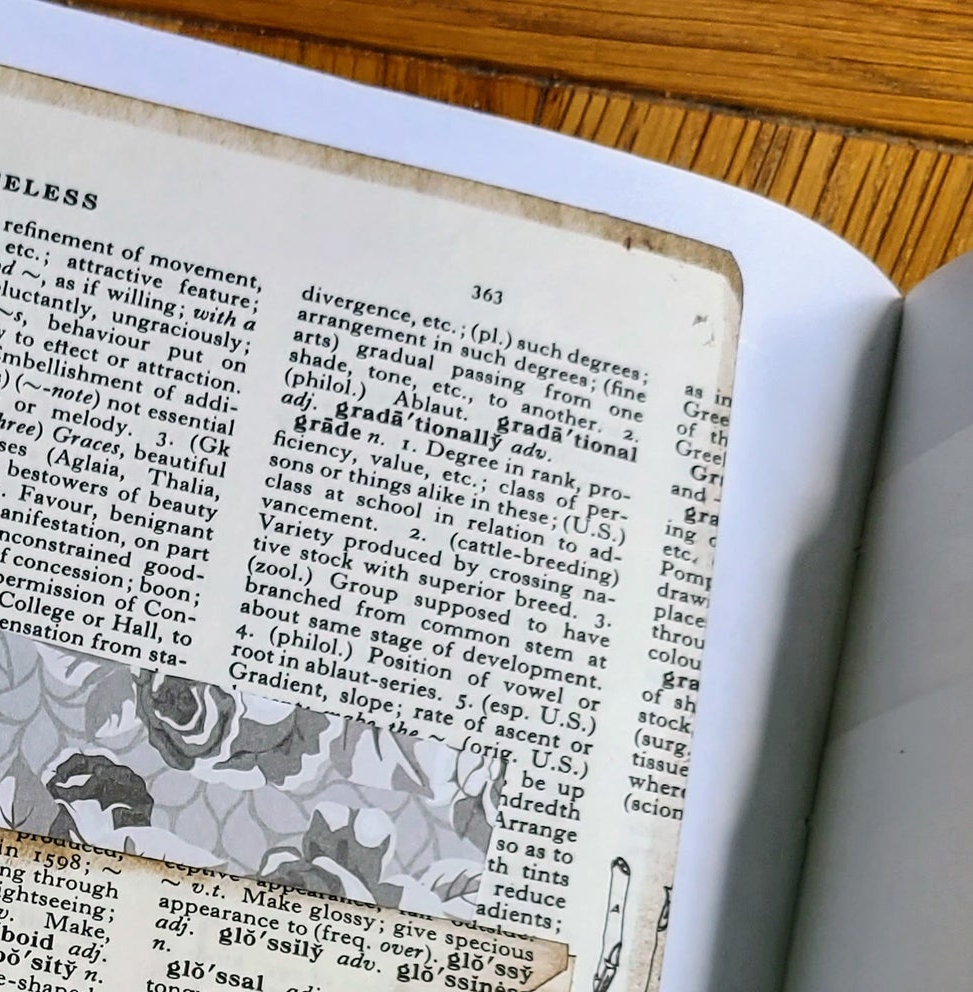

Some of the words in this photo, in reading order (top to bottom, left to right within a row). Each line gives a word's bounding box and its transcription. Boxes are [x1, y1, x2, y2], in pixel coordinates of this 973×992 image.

[2, 220, 115, 257] refinement
[121, 245, 146, 263] of
[148, 254, 263, 295] movement,
[66, 257, 164, 290] attractive
[471, 284, 504, 306] 363
[296, 309, 428, 348] arrangement
[433, 339, 453, 354] in
[460, 346, 506, 367] such
[603, 378, 647, 404] (fine
[301, 284, 417, 329] divergence,
[470, 322, 513, 351] (pl.)
[516, 339, 562, 360] such
[15, 330, 35, 348] to
[43, 338, 100, 363] effect
[106, 354, 131, 369] or
[136, 360, 241, 395] attraction.
[153, 384, 178, 402] of
[183, 391, 239, 414] addi-
[288, 347, 353, 378] shade,
[368, 365, 418, 392] tone,
[431, 382, 474, 405] etc.,
[489, 392, 508, 409] to
[520, 402, 598, 431] another.
[623, 429, 639, 443] 2.
[292, 330, 340, 354] arts)
[355, 344, 435, 371] gradual
[450, 364, 527, 396] passing
[544, 382, 592, 410] from
[609, 404, 644, 423] one
[106, 398, 142, 417] not
[147, 407, 236, 437] essential
[46, 446, 125, 483] (Aglaia,
[147, 467, 221, 503] Thalia,
[261, 496, 378, 532] vancement.
[408, 527, 427, 542] 2.
[449, 531, 620, 589] (cattle-breeding)
[264, 472, 313, 496] class
[324, 488, 345, 503] at
[355, 493, 423, 520] school
[433, 511, 455, 527] in
[466, 517, 545, 547] relation
[558, 537, 578, 554] to
[589, 546, 623, 563] ad-
